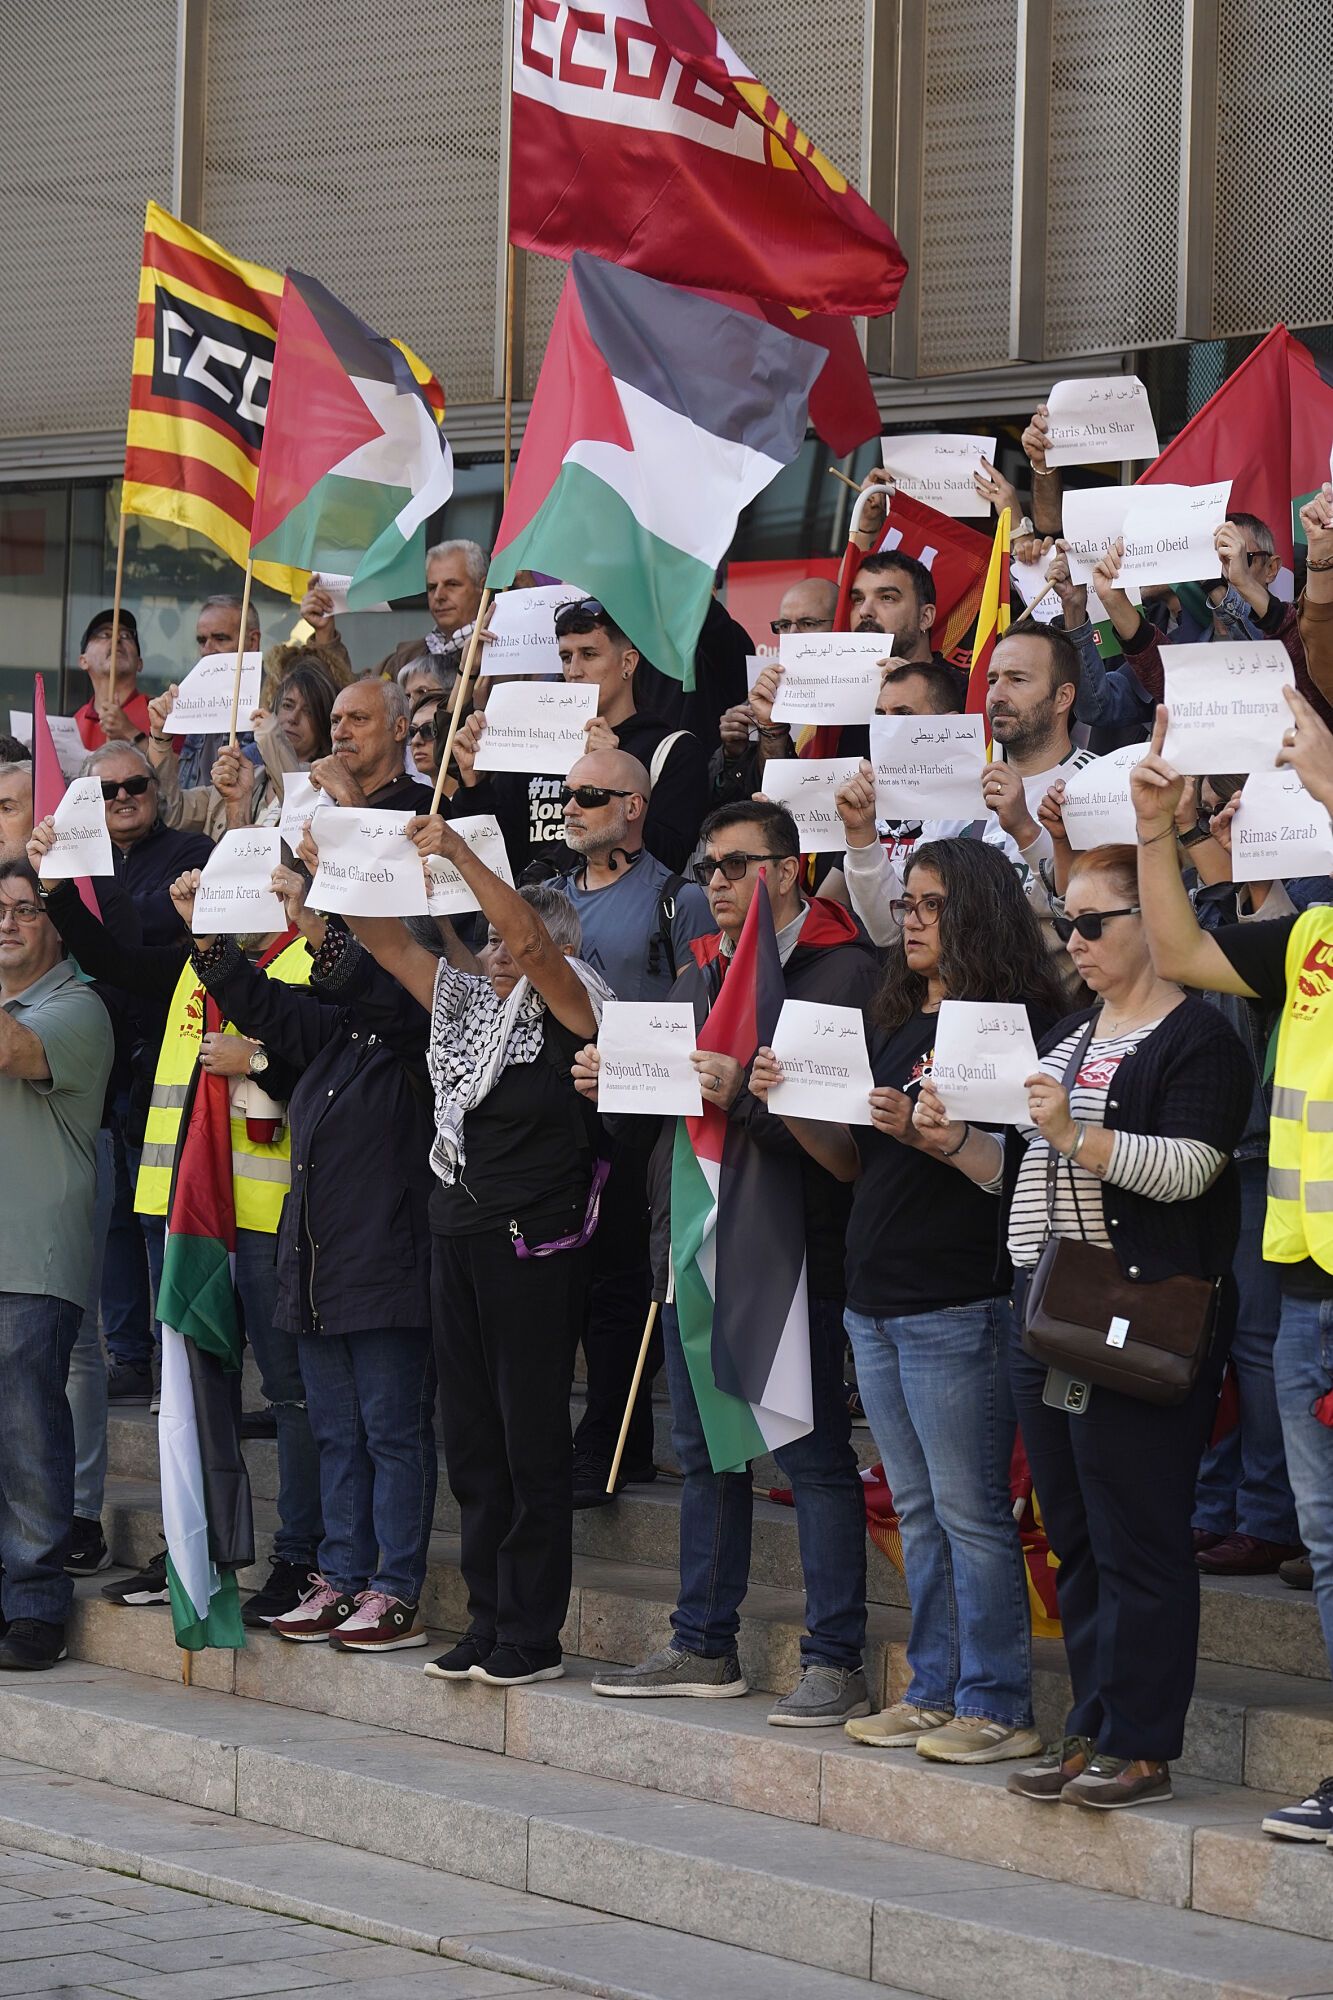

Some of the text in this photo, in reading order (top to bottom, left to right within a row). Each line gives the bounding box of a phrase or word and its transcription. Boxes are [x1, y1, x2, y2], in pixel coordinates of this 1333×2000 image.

[1051, 422, 1136, 439] Faris Abu Shar
[919, 479, 940, 490] Abu
[943, 478, 977, 490] Saada
[1072, 539, 1098, 554] Tala
[1125, 536, 1190, 558] Sham Obeid
[490, 635, 520, 648] Ikhlas
[836, 646, 857, 657] حسن
[860, 645, 883, 654] محمد
[786, 674, 873, 686] Mohammed Hassan al-
[538, 693, 590, 709] ابراهيم عابد
[784, 689, 816, 700] Harbeiti
[175, 695, 252, 710] Suhaib al-Ajrmi
[1172, 700, 1279, 718] Walid Abu Thuraya
[487, 726, 584, 741] Ibrahim Ishaq Abed
[878, 764, 954, 775] Ahmed al-Harbeiti
[908, 779, 920, 787] anys
[1065, 791, 1128, 806] Ahmed Abu Layla
[809, 809, 831, 822] Abu
[55, 826, 103, 841] man Shaheen
[360, 825, 384, 838] غريب
[1239, 824, 1317, 844] Rimas Zarab
[253, 846, 272, 857] مريم
[322, 861, 395, 883] Fidaa Ghareeb
[429, 870, 462, 885] Malak
[201, 886, 261, 900] Mariam Krera
[649, 1016, 688, 1032] سجود طه
[813, 1020, 858, 1037] سمير تمراز
[977, 1018, 1025, 1036] سارة قنديل
[604, 1061, 670, 1079] Sujoud Taha
[777, 1058, 850, 1078] amir Tamraz
[934, 1063, 997, 1082] Sara Qandil
[824, 1081, 848, 1089] aniversari
